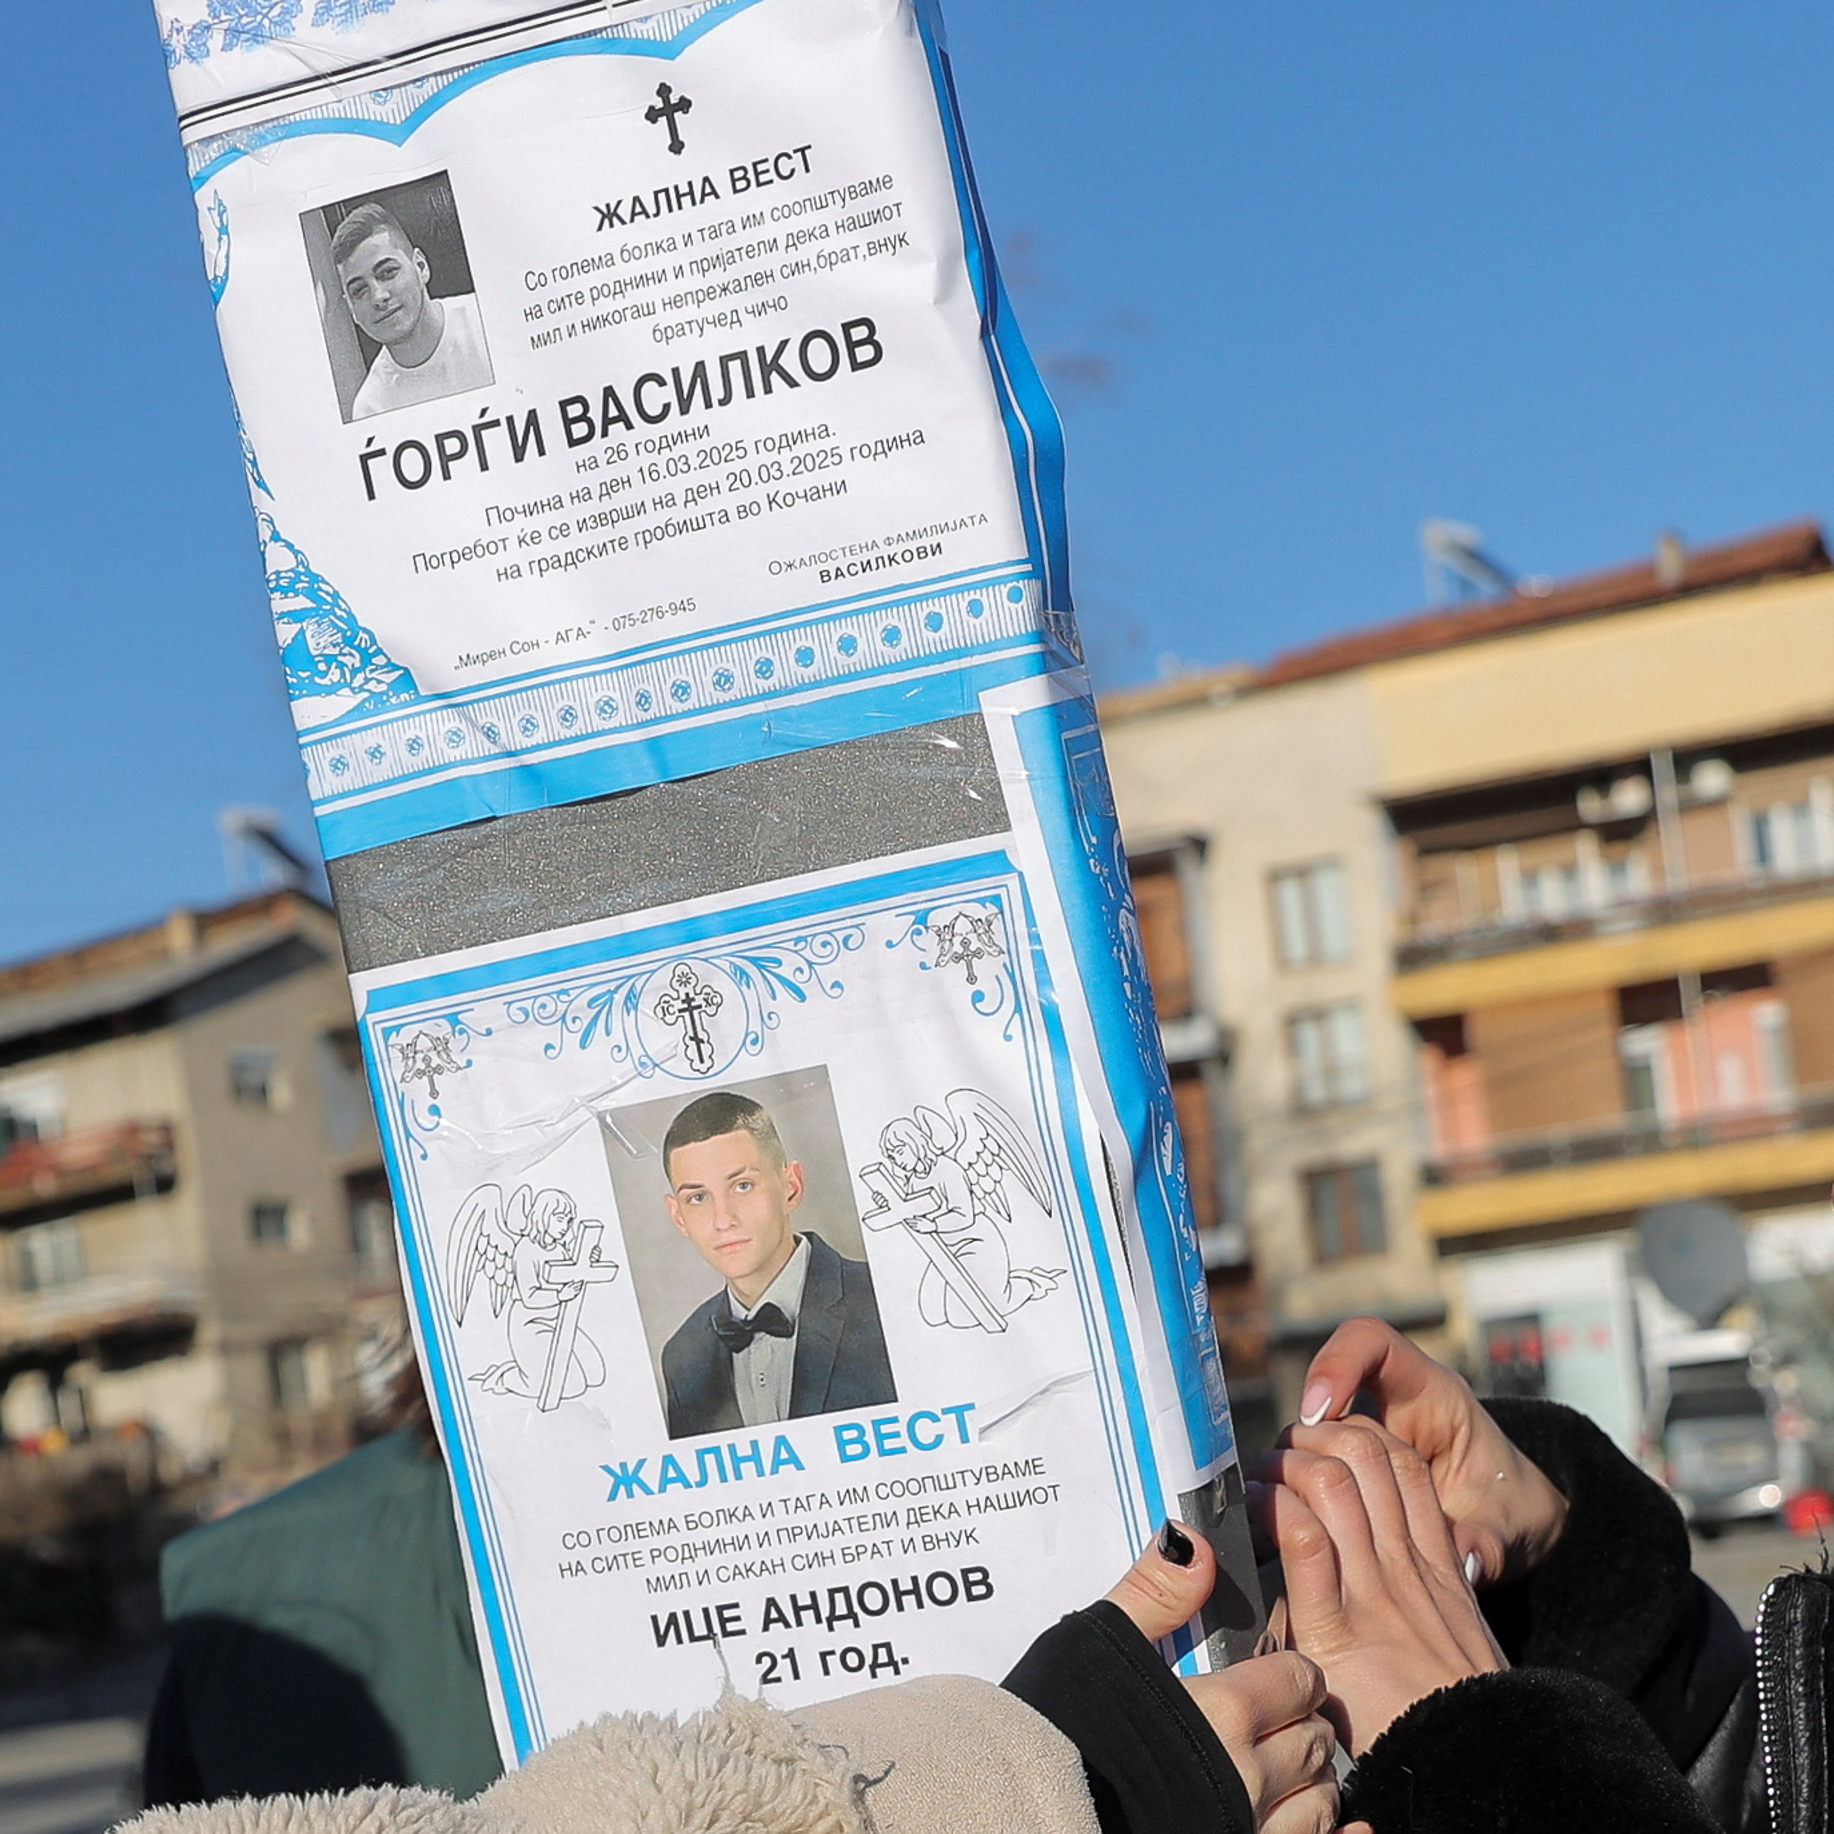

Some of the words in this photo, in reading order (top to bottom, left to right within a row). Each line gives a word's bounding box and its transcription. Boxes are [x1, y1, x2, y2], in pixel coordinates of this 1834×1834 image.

[524, 270, 548, 291] Со
[551, 252, 616, 283] голема
[620, 236, 678, 263] болка
[682, 232, 694, 248] и
[696, 219, 737, 243] тага
[740, 211, 765, 231] им
[770, 174, 894, 222] соопштуваме
[591, 175, 721, 233] ЖАЛНА
[728, 144, 812, 195] ВЕСТ
[523, 304, 544, 323] на
[547, 290, 586, 315] сите
[589, 268, 668, 307] роднини
[672, 264, 685, 280] и
[689, 237, 779, 278] пријатели
[784, 223, 831, 254] дека
[834, 201, 903, 235] нашиот
[530, 327, 563, 350] мил
[566, 322, 578, 339] и
[580, 301, 656, 334] никогаш
[661, 268, 776, 312] непрежален
[779, 231, 910, 280] син,брат,внук
[652, 309, 743, 343] братучед
[744, 295, 788, 319] чичо
[358, 408, 547, 500] ЃОРЃИ
[557, 317, 884, 449] ВАСИЛКОВ
[575, 455, 600, 474] на
[604, 442, 629, 466] 26
[634, 424, 711, 457] години
[412, 537, 509, 573] Погребот
[517, 527, 542, 548] ќе
[548, 522, 571, 540] се
[576, 500, 647, 533] изврши
[652, 492, 678, 512] на
[683, 480, 721, 508] ден
[726, 446, 843, 493] 20.03.2025
[849, 429, 926, 462] година
[485, 494, 565, 526] Почина
[569, 486, 594, 506] на
[598, 474, 632, 500] ден
[637, 441, 748, 485] 16.03.2025
[754, 423, 836, 455] година.
[496, 563, 523, 582] на
[528, 536, 629, 575] градските
[634, 508, 731, 550] гробишта
[736, 500, 762, 520] во
[766, 479, 848, 512] Кочани
[819, 541, 943, 584] ВАСИЛКОВИ
[509, 639, 540, 655] Сон
[612, 597, 696, 632] 075-276-945
[598, 1434, 806, 1503] ЖАЛНА
[832, 1402, 977, 1464] ВЕСТ
[558, 1560, 588, 1579] НА
[591, 1550, 646, 1574] СИТЕ
[649, 1533, 752, 1565] РОДНИНИ
[755, 1530, 772, 1549] И
[776, 1510, 900, 1546] ПРИЈАТЕЛИ
[905, 1501, 962, 1530] ДЕКА
[965, 1484, 1061, 1516] НАШИОТ
[562, 1530, 592, 1551] СО
[595, 1517, 681, 1545] ГОЛЕМА
[683, 1505, 756, 1531] БОЛКА
[759, 1501, 775, 1519] И
[778, 1492, 833, 1516] ТАГА
[836, 1485, 870, 1507] ИМ
[875, 1457, 1047, 1501] СООПШТУВАМЕ
[645, 1571, 691, 1594] МИЛ
[695, 1568, 712, 1587] И
[715, 1556, 787, 1583] САКАН
[791, 1549, 836, 1572] СИН
[840, 1539, 894, 1564] БРАТ
[900, 1536, 917, 1555] И
[921, 1527, 980, 1552] ВНУК
[650, 1601, 748, 1650] ИЦЕ
[761, 1565, 995, 1633] АНДОНОВ
[755, 1646, 801, 1684] 21
[818, 1641, 910, 1680] год.
